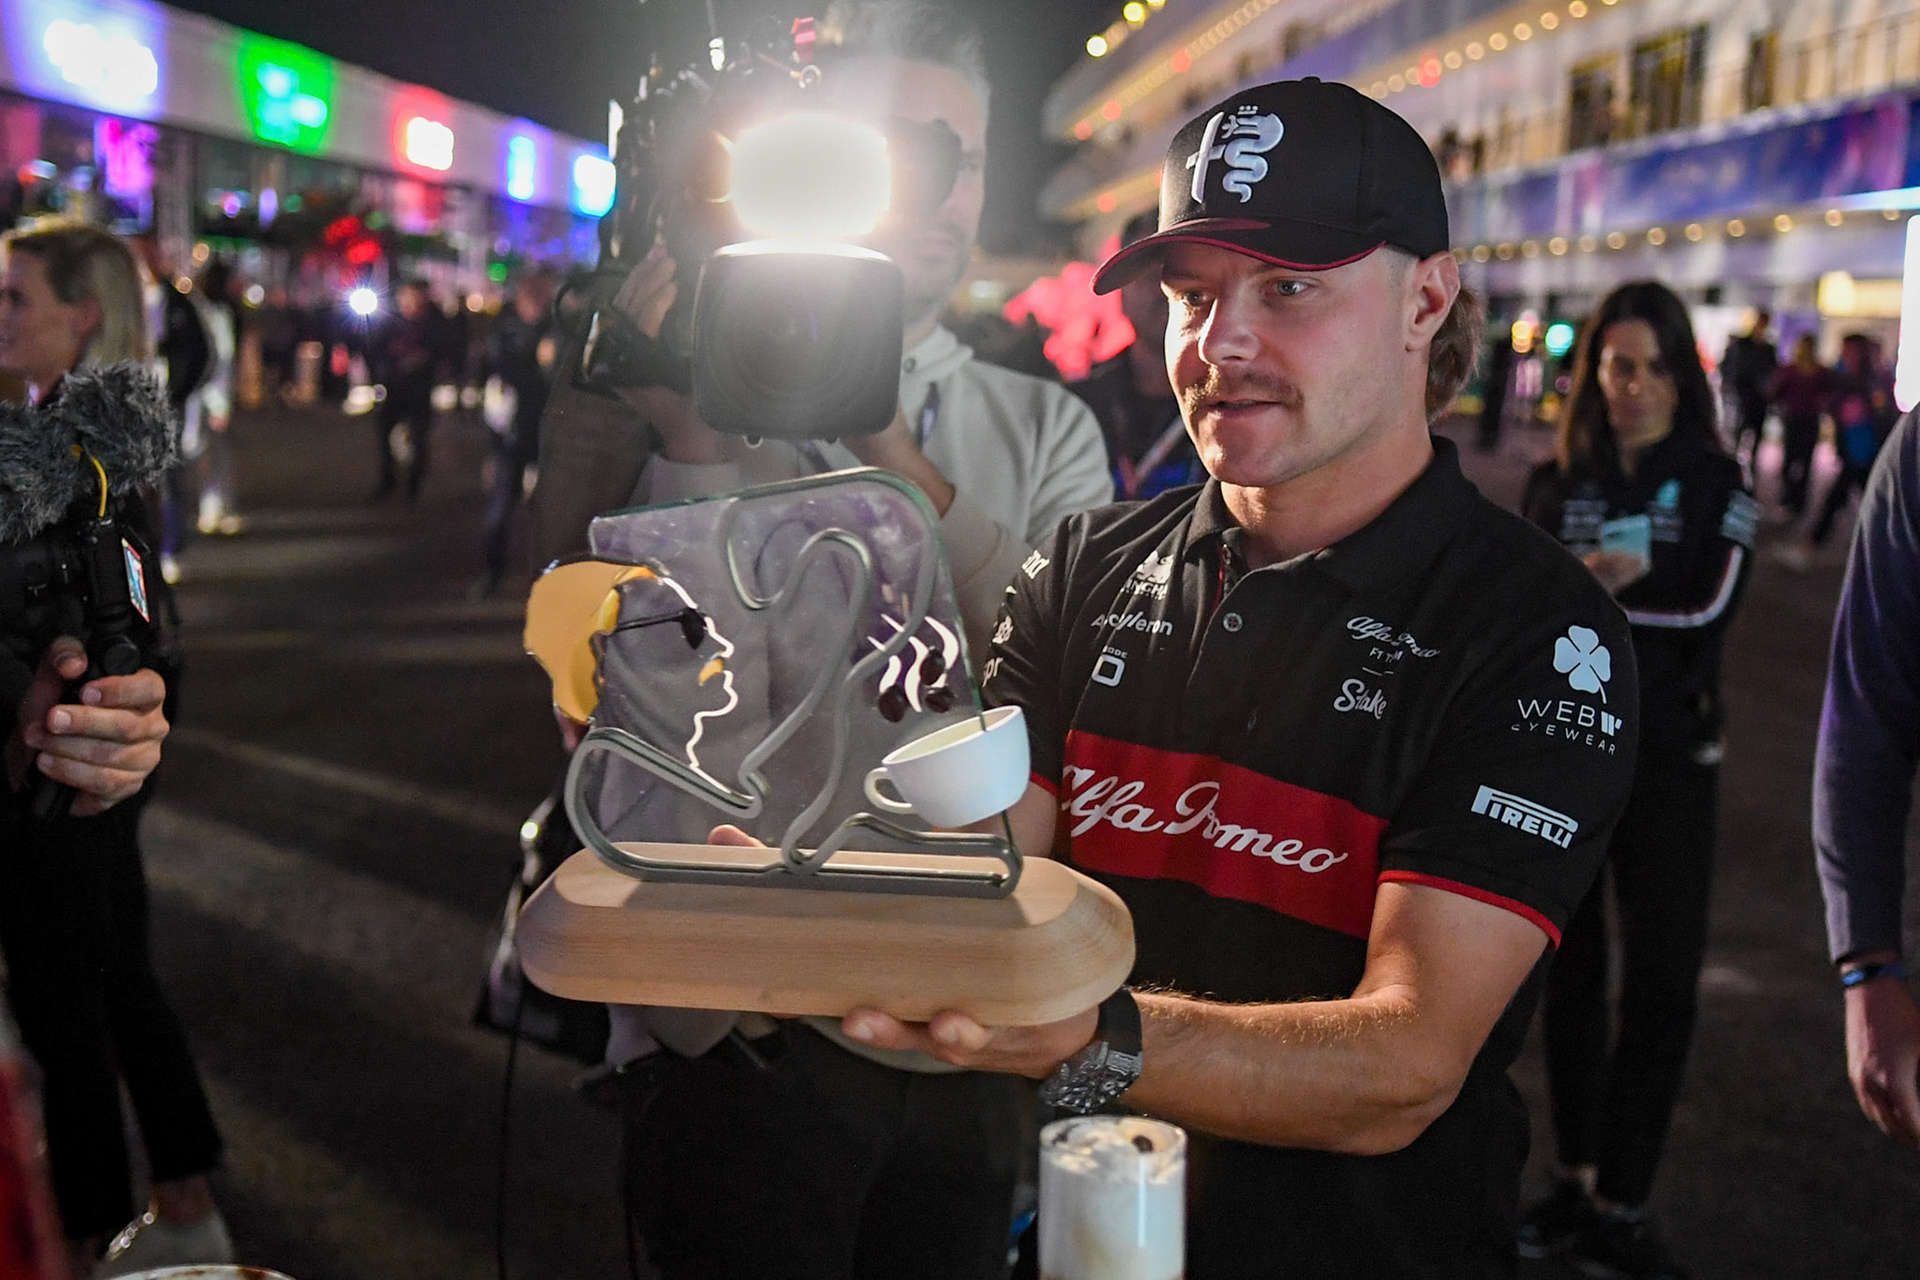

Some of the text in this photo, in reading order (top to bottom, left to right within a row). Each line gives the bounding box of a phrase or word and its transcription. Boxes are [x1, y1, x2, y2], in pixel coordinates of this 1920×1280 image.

[1333, 678, 1387, 720] Stake
[1517, 699, 1596, 728] WEB
[1471, 784, 1580, 849] PIRELLI
